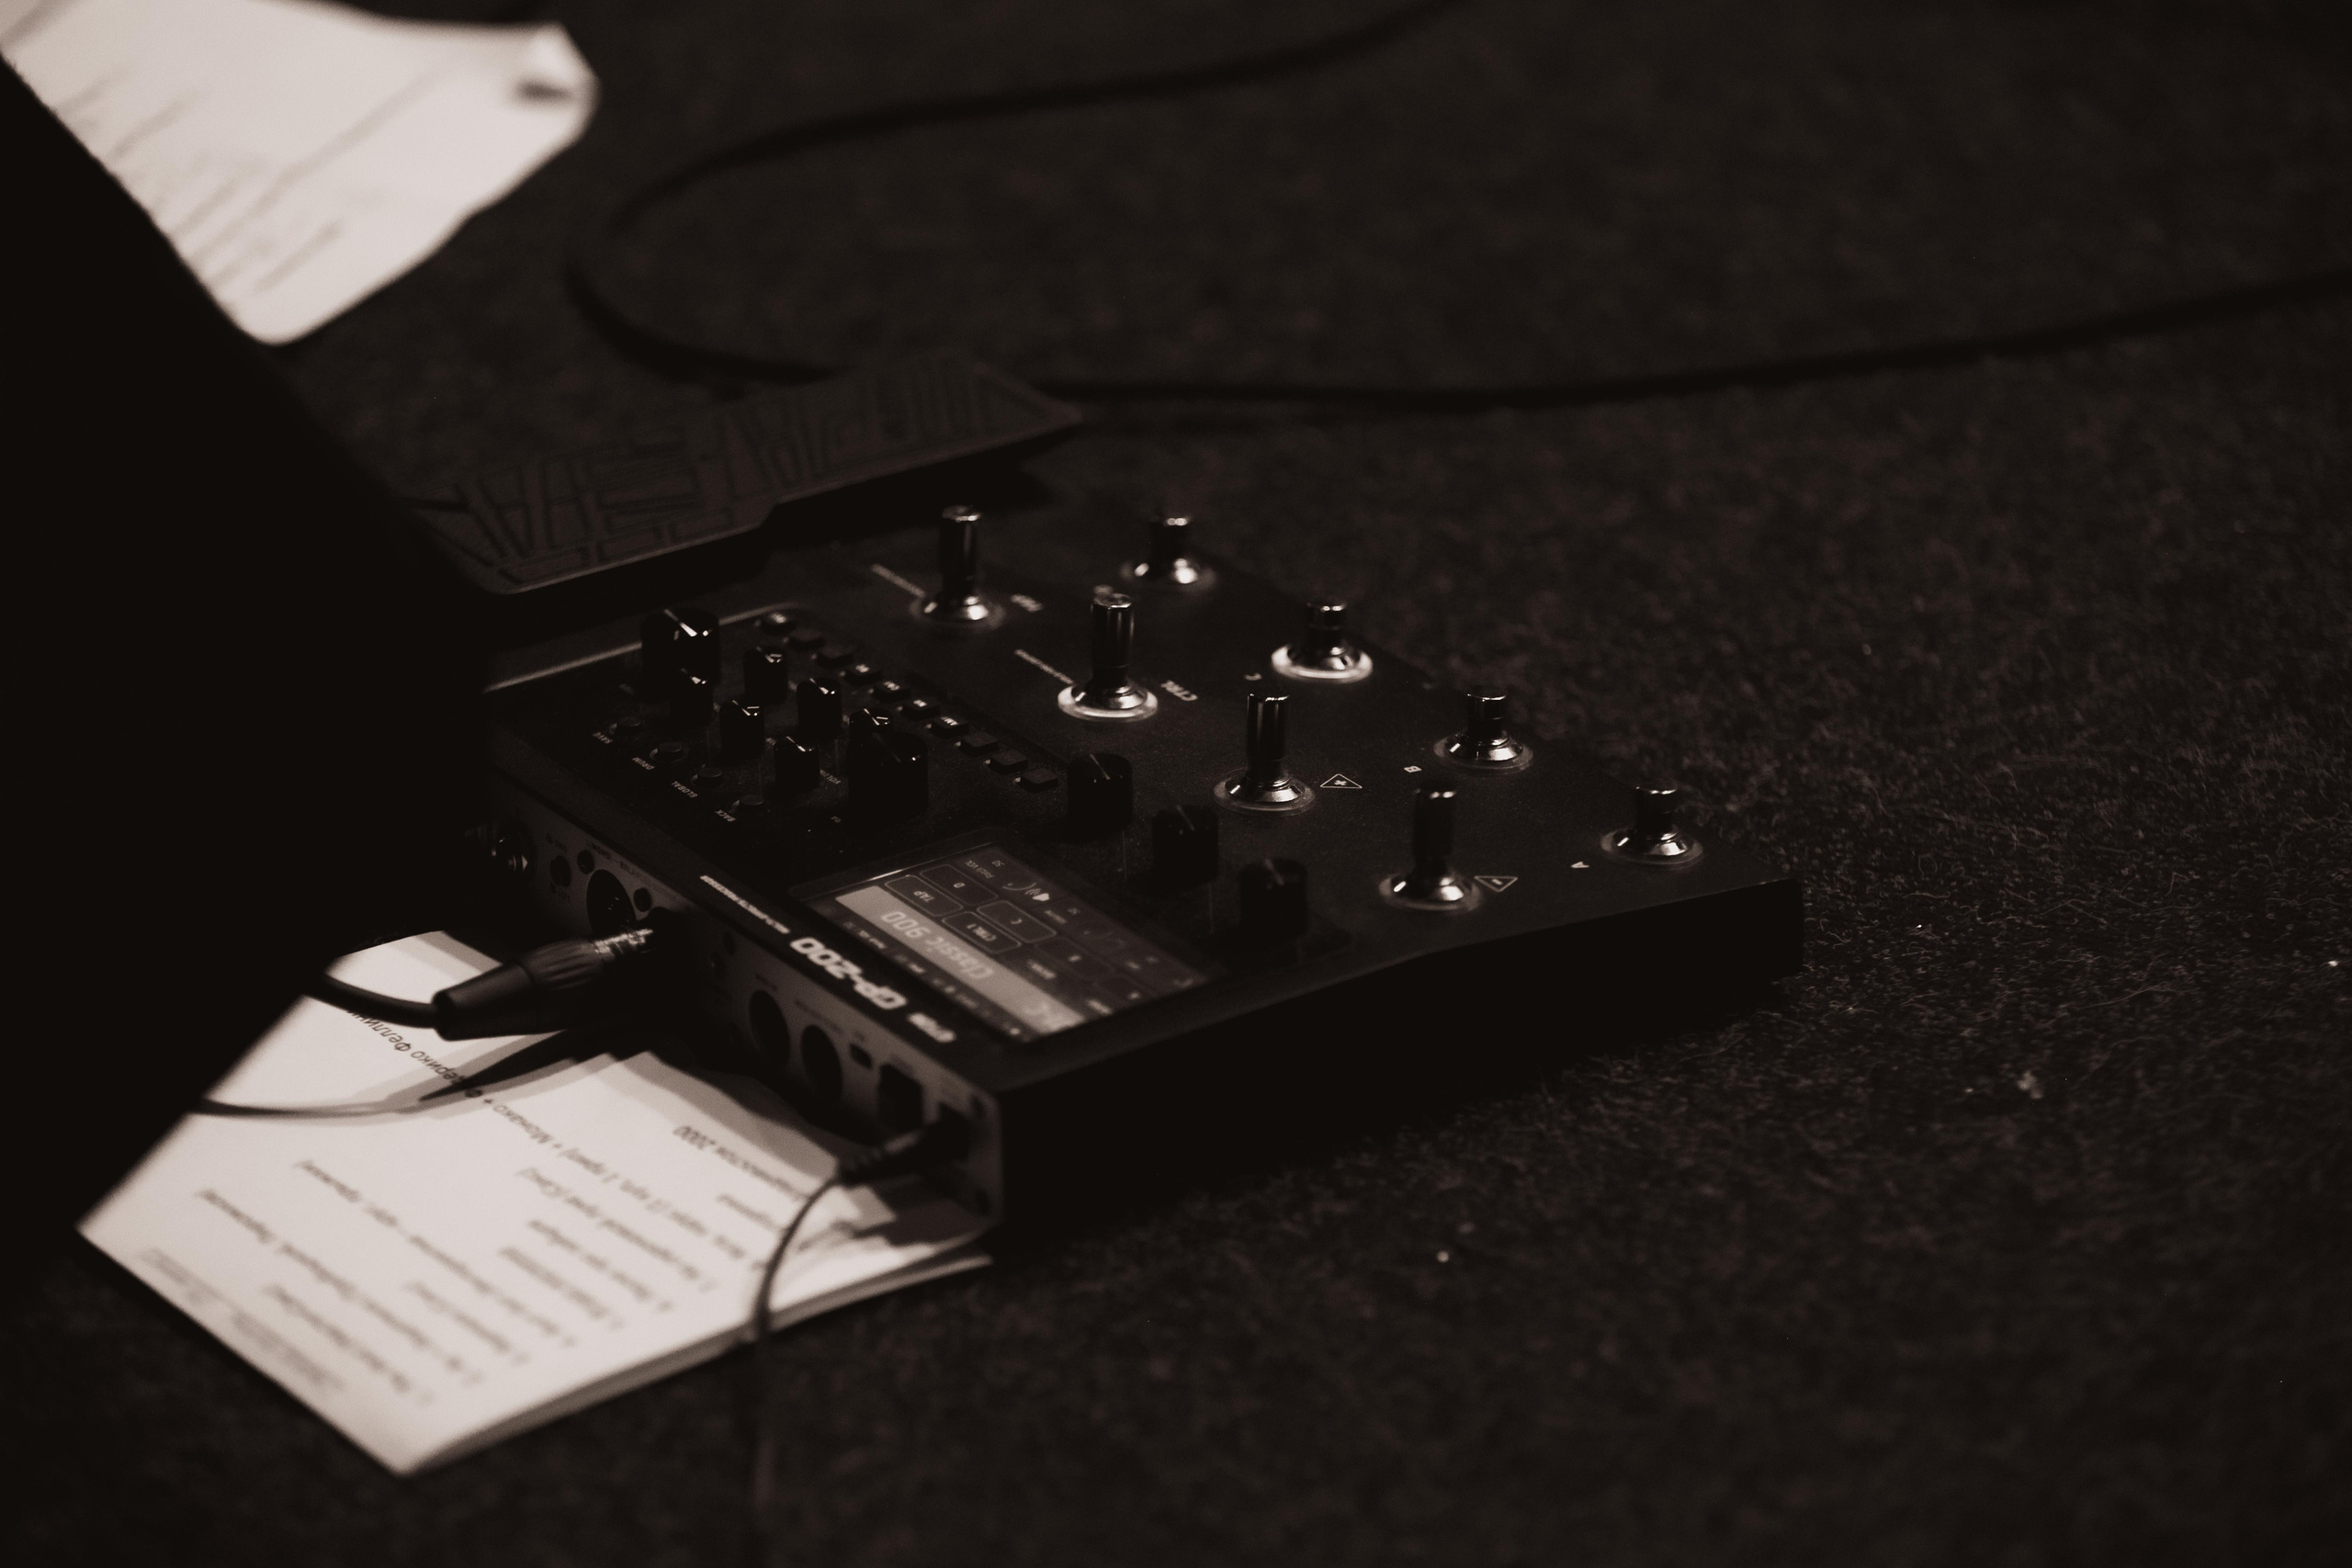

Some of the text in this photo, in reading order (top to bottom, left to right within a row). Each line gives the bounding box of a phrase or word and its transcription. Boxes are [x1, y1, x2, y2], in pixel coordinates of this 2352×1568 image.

[1160, 679, 1198, 702] CTRL
[591, 730, 613, 744] SAVE
[631, 755, 655, 770] DRUM
[670, 780, 698, 798] GLOBAL
[714, 808, 736, 822] BACK
[912, 888, 934, 902] TAP
[879, 909, 924, 940] 900
[969, 924, 998, 941] CTRL
[927, 935, 994, 981] Classic
[789, 937, 907, 1010] GP-200
[408, 1048, 485, 1100] Фдерико
[492, 1103, 554, 1144] Монако
[671, 1123, 717, 1151] 2000
